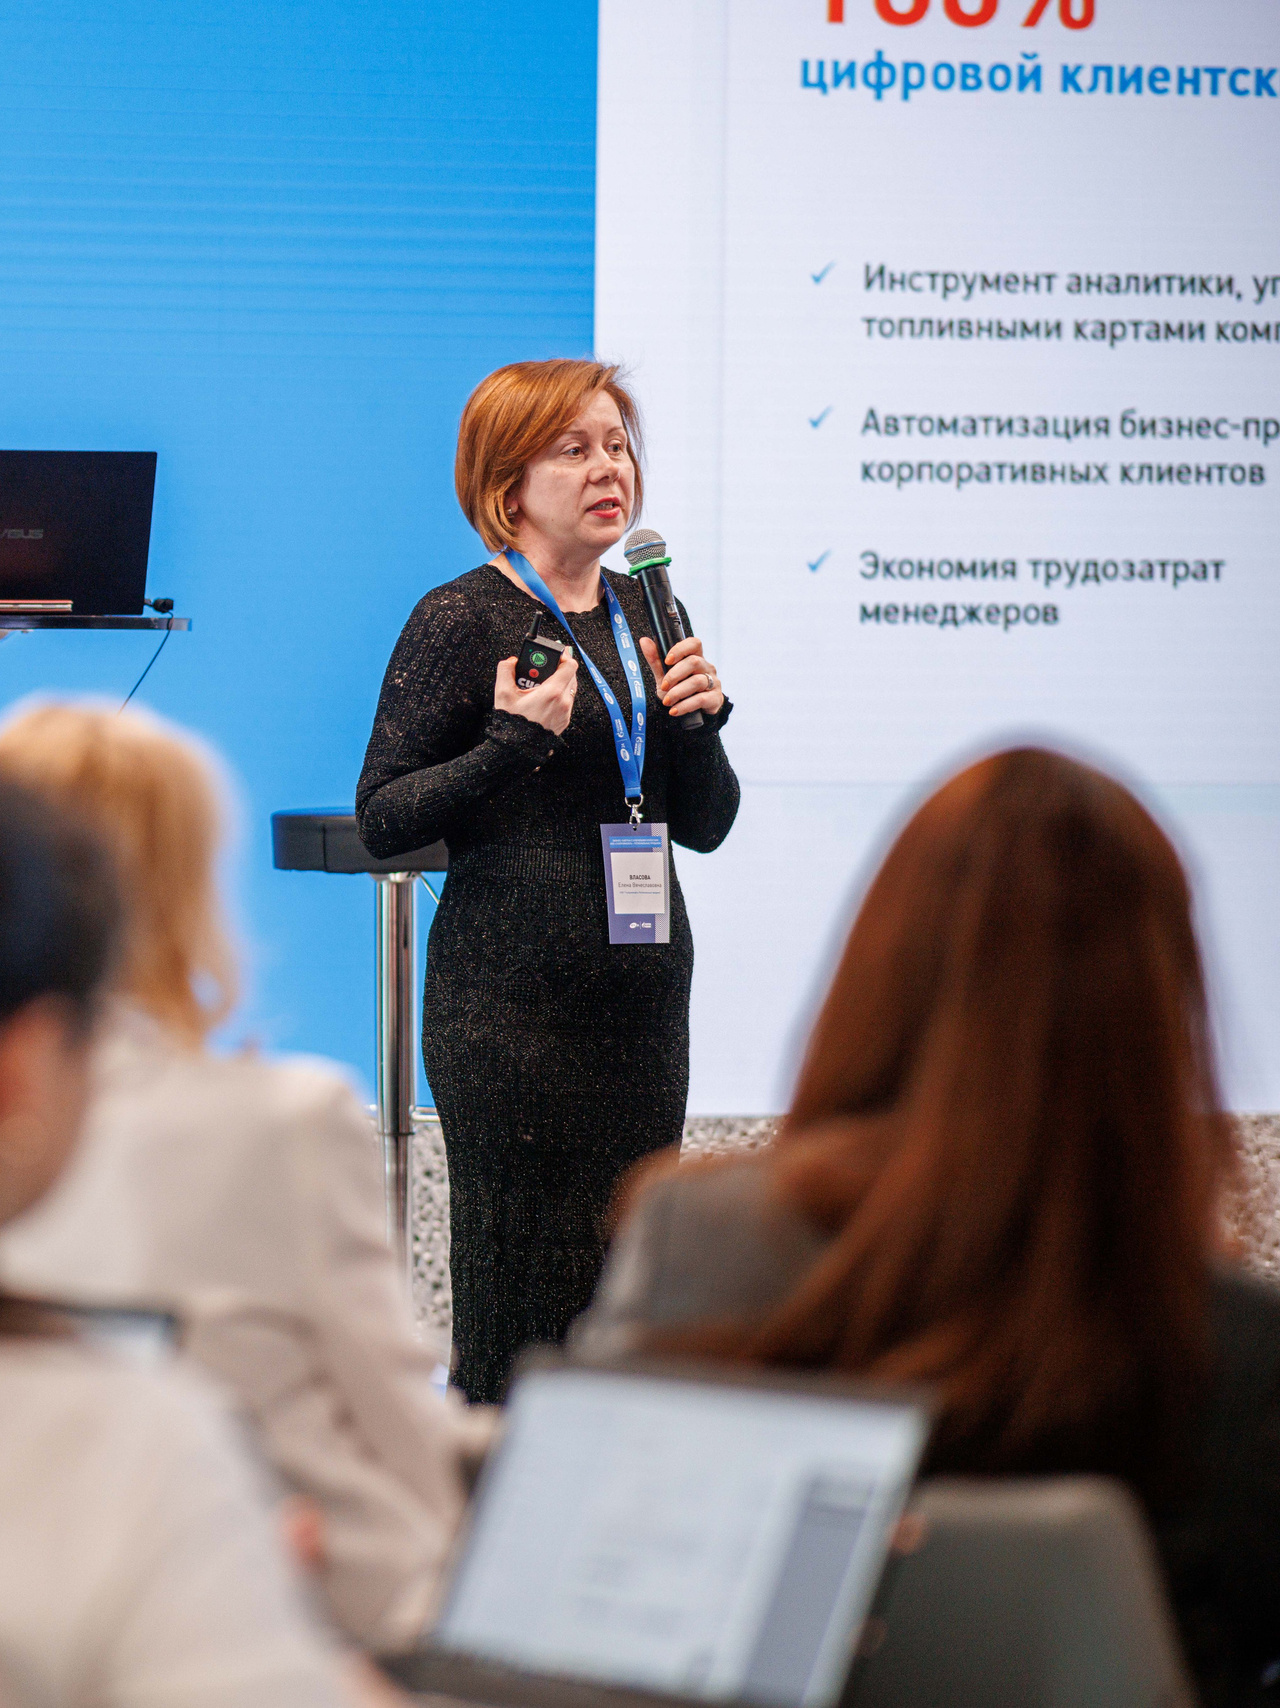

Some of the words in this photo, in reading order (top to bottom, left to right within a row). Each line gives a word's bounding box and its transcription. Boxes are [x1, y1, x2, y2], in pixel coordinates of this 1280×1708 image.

[800, 49, 1043, 102] цифровой
[1061, 64, 1278, 99] клиентск
[864, 263, 1058, 302] Инструмент
[1066, 272, 1243, 302] аналитики,
[861, 316, 1062, 342] топливными
[1073, 318, 1206, 349] картами
[861, 407, 1111, 444] Автоматизация
[1119, 408, 1280, 448] бизнес-пр
[861, 460, 1110, 491] корпоративных
[1119, 463, 1267, 486] клиентов
[0, 528, 44, 539] ASUS
[859, 550, 1018, 582] Экономия
[1027, 557, 1227, 589] трудозатрат
[859, 602, 1061, 633] менеджеров
